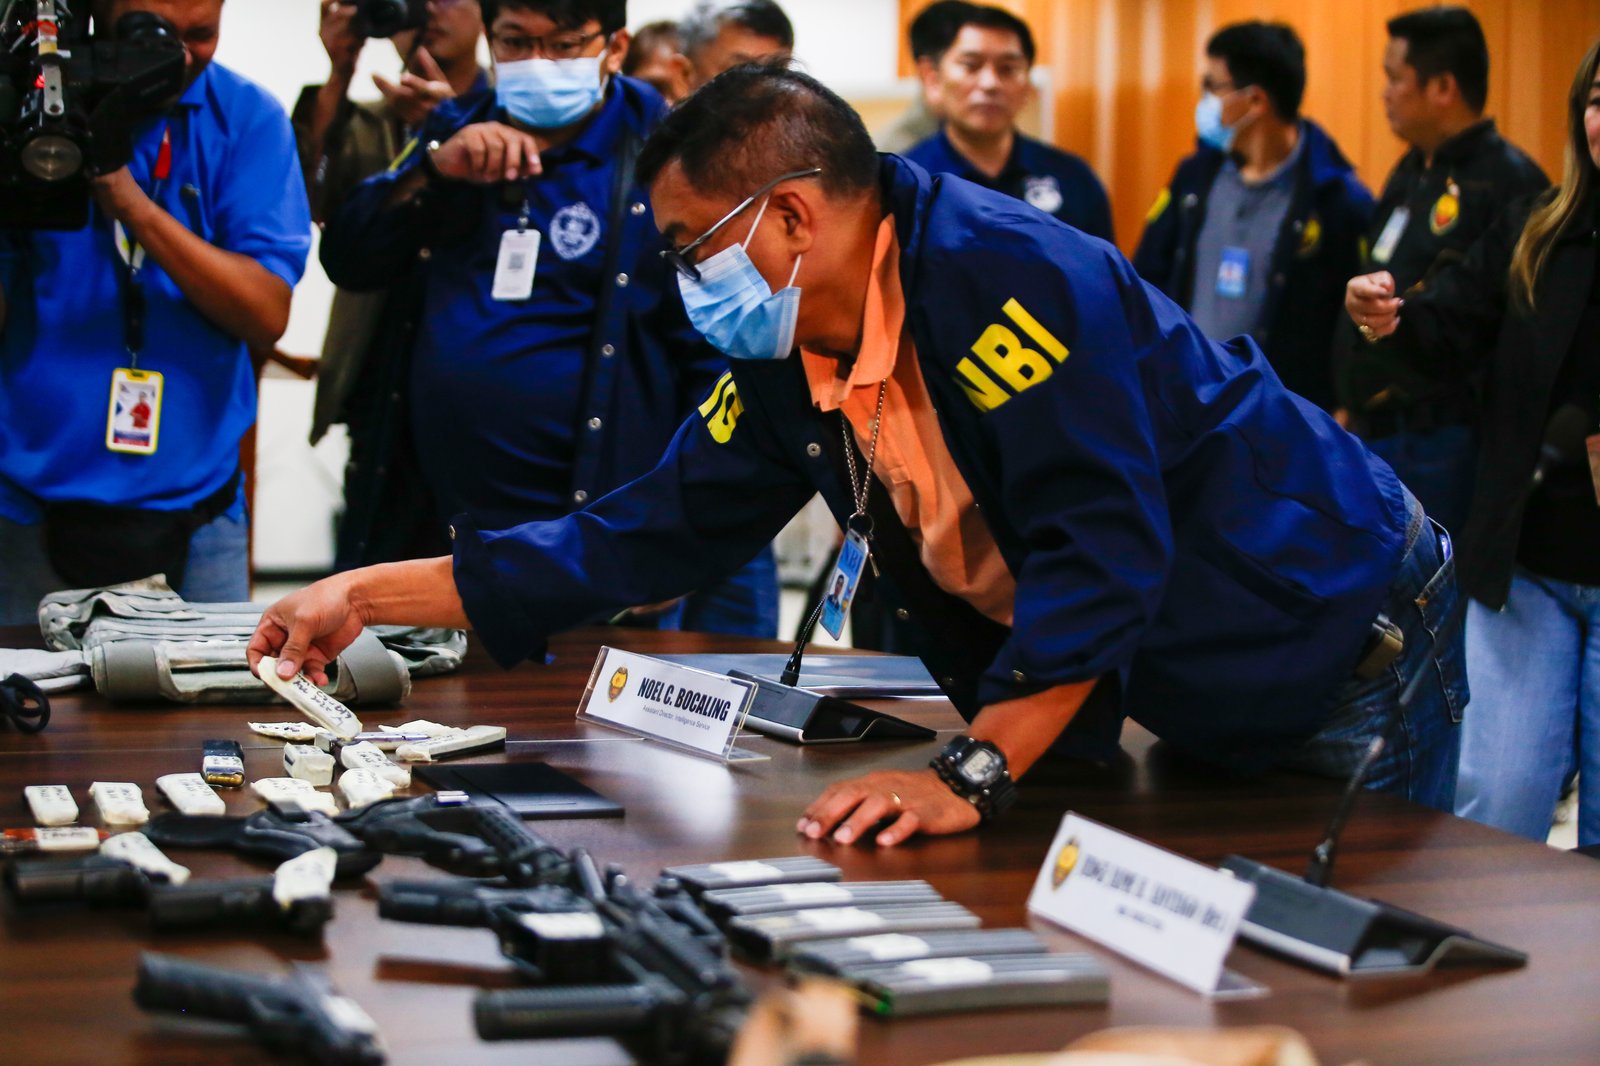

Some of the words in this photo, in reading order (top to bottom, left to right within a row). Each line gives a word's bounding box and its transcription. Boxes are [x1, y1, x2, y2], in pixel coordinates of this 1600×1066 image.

[952, 297, 1070, 413] NBI
[637, 677, 665, 702] NOEL
[663, 684, 675, 706] C.
[674, 688, 731, 721] BOCALING
